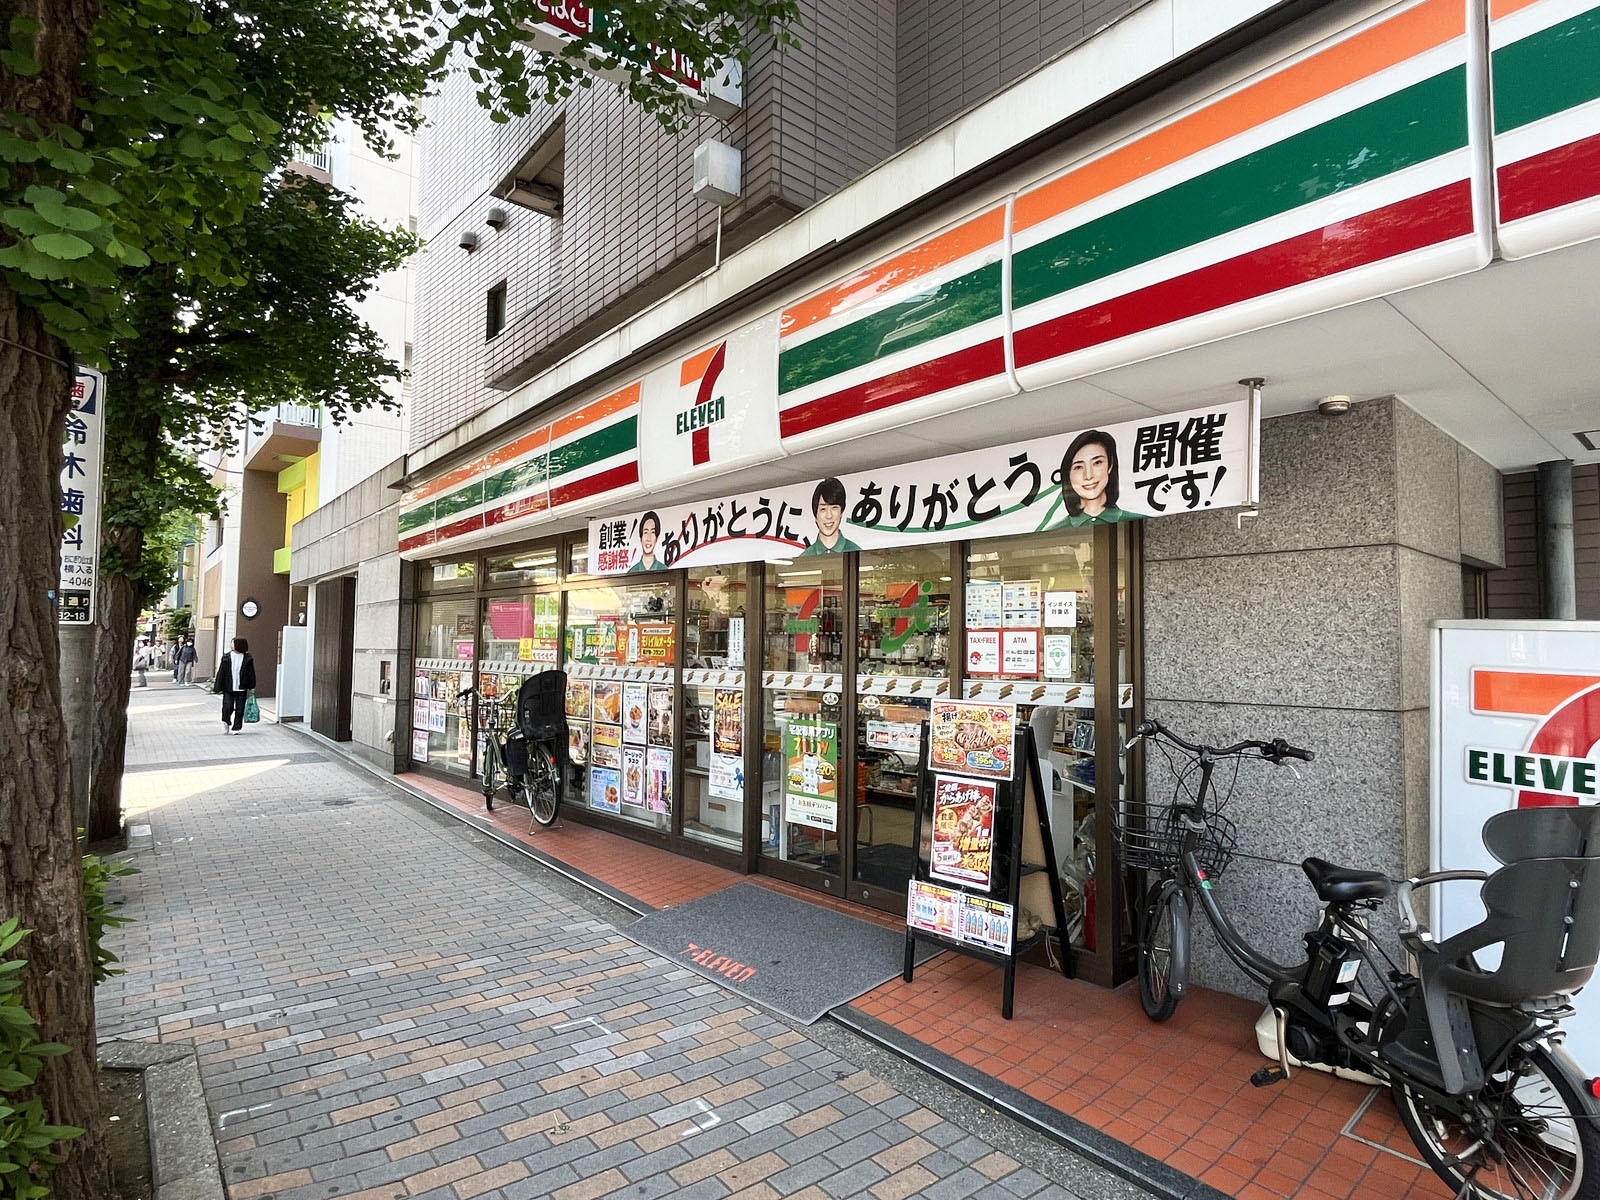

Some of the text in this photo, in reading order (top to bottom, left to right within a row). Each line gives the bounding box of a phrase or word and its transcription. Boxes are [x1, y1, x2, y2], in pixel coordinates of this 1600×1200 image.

[1132, 413, 1227, 473] 開催
[1134, 465, 1226, 512] です!
[661, 497, 812, 567] ありがとうに、
[1468, 749, 1596, 795] ELEVE
